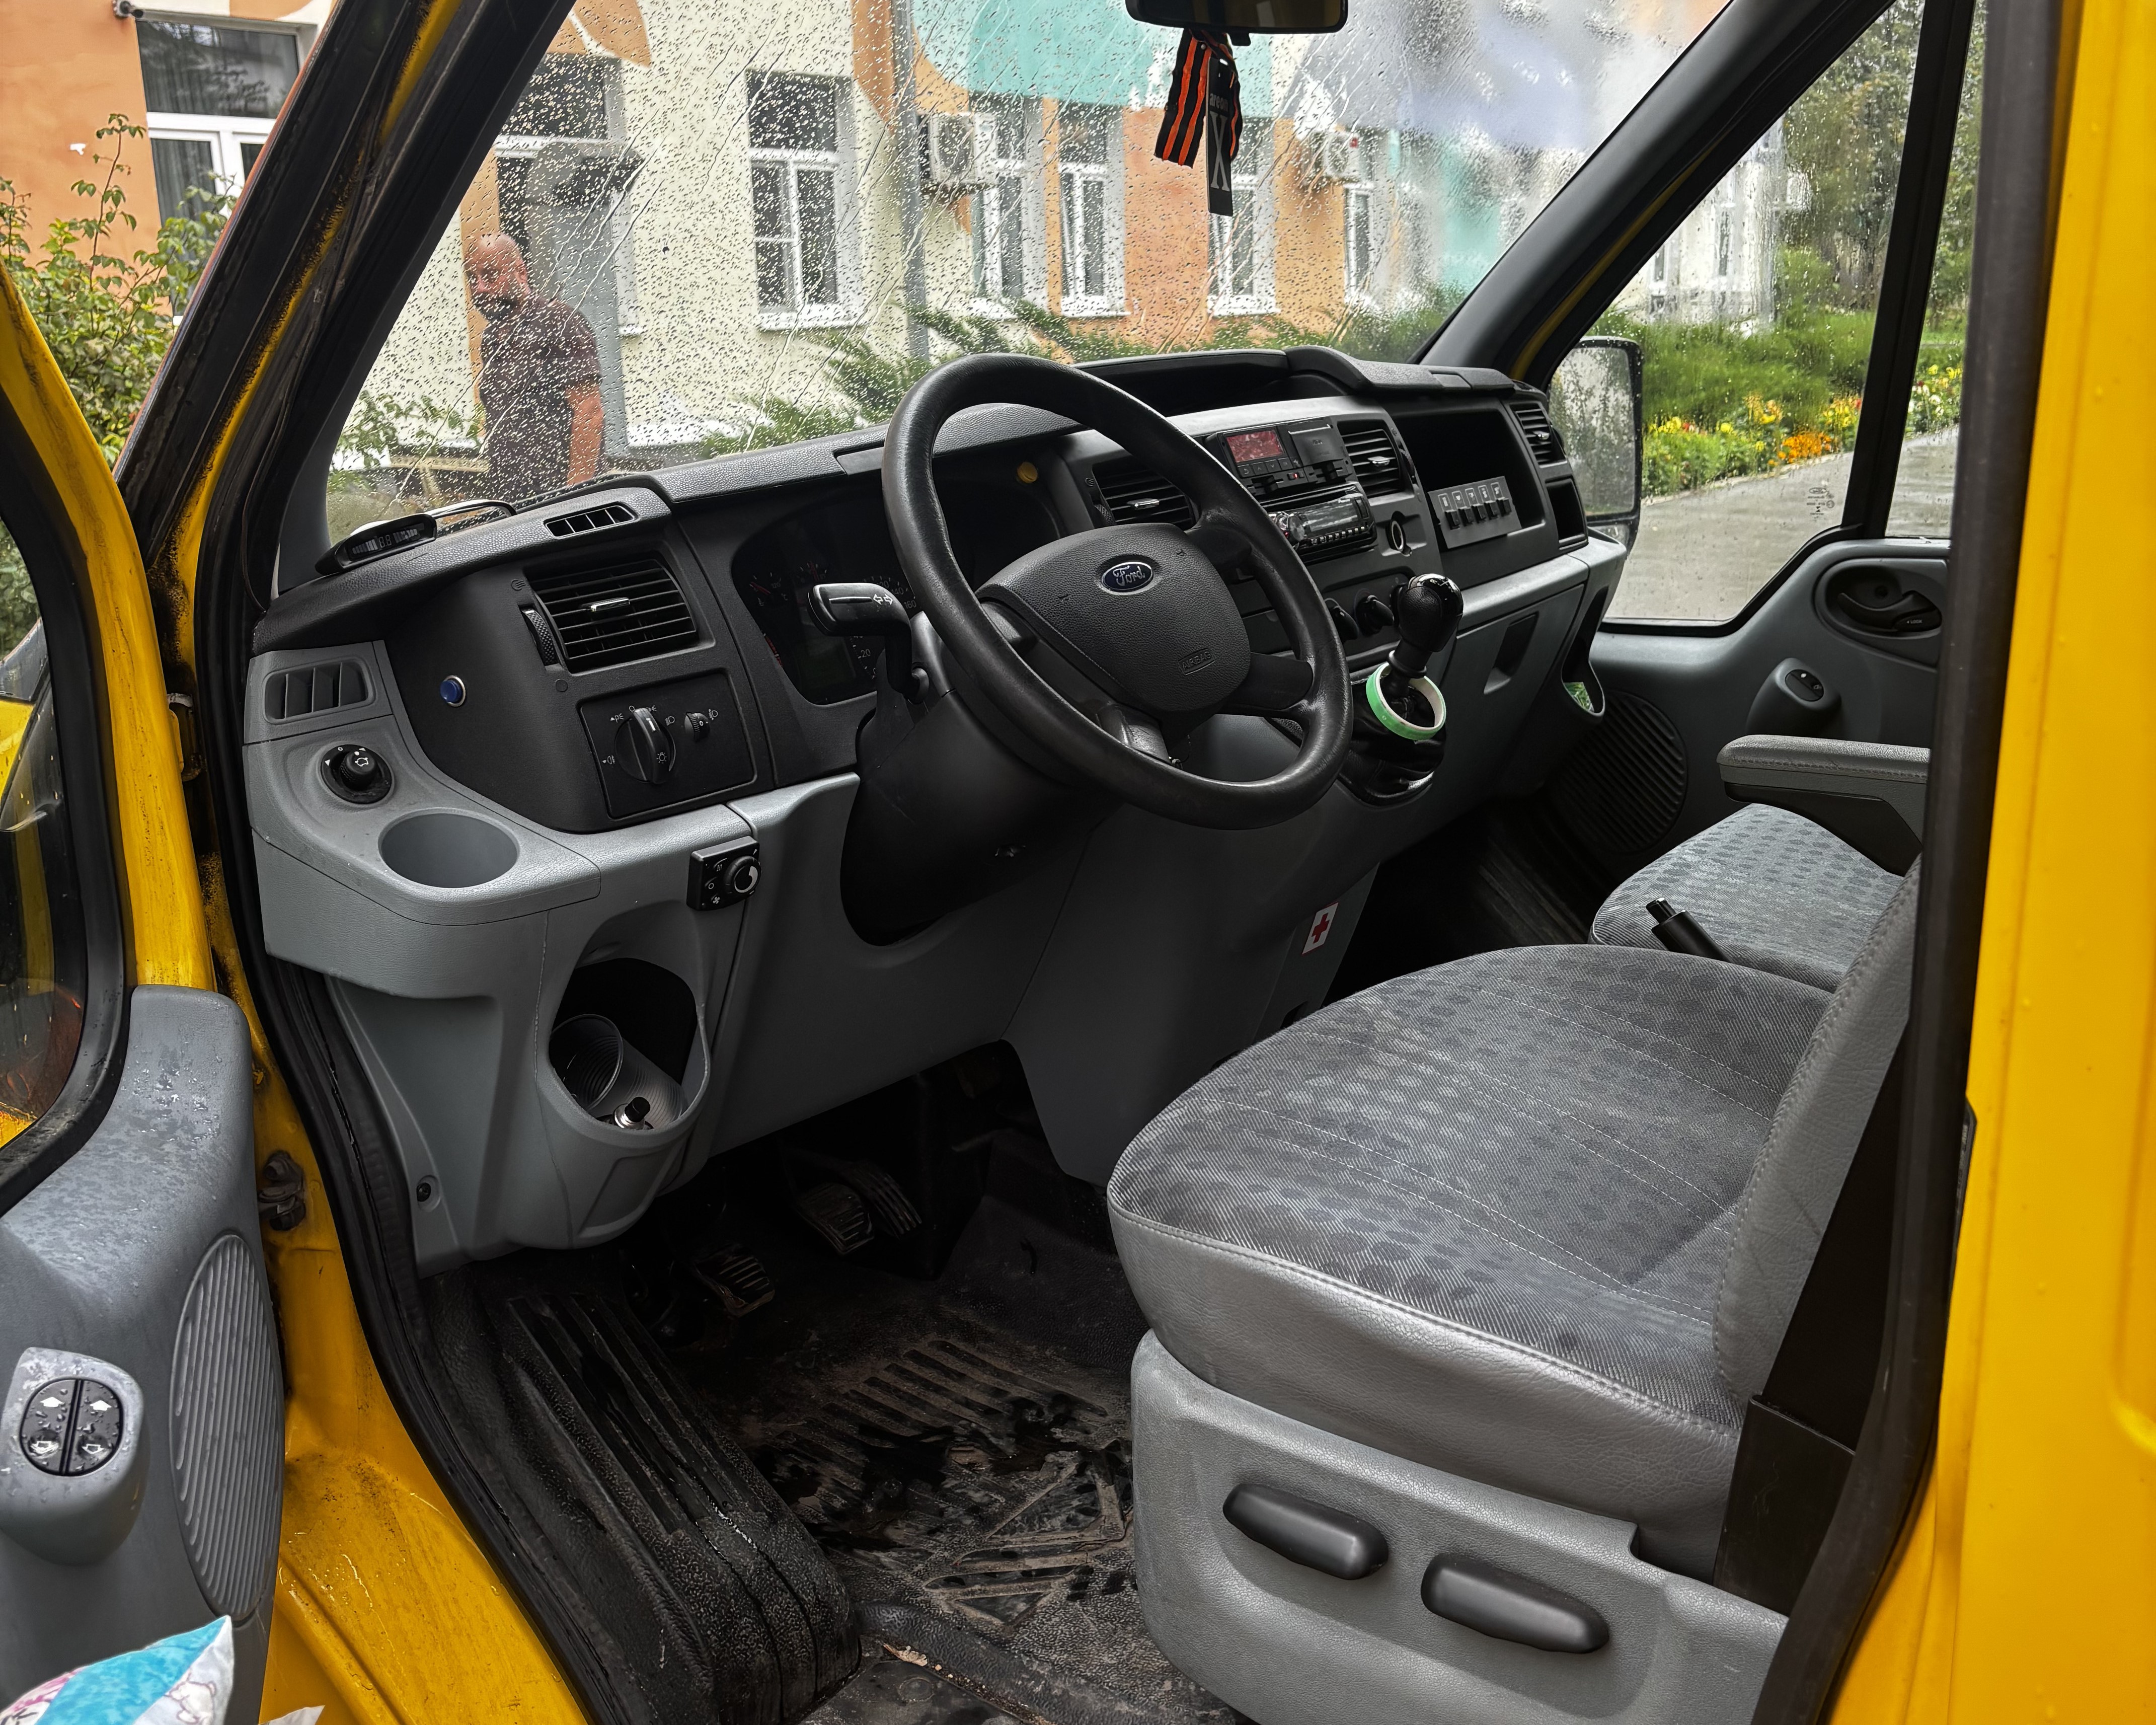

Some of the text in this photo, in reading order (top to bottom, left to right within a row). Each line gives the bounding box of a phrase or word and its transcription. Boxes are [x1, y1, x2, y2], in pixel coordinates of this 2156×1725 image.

[1209, 111, 1230, 192] X
[1113, 565, 1145, 586] Ford
[891, 587, 904, 595] 140
[904, 599, 917, 609] 160
[861, 649, 871, 658] 20
[1182, 651, 1211, 670] AIRBAG
